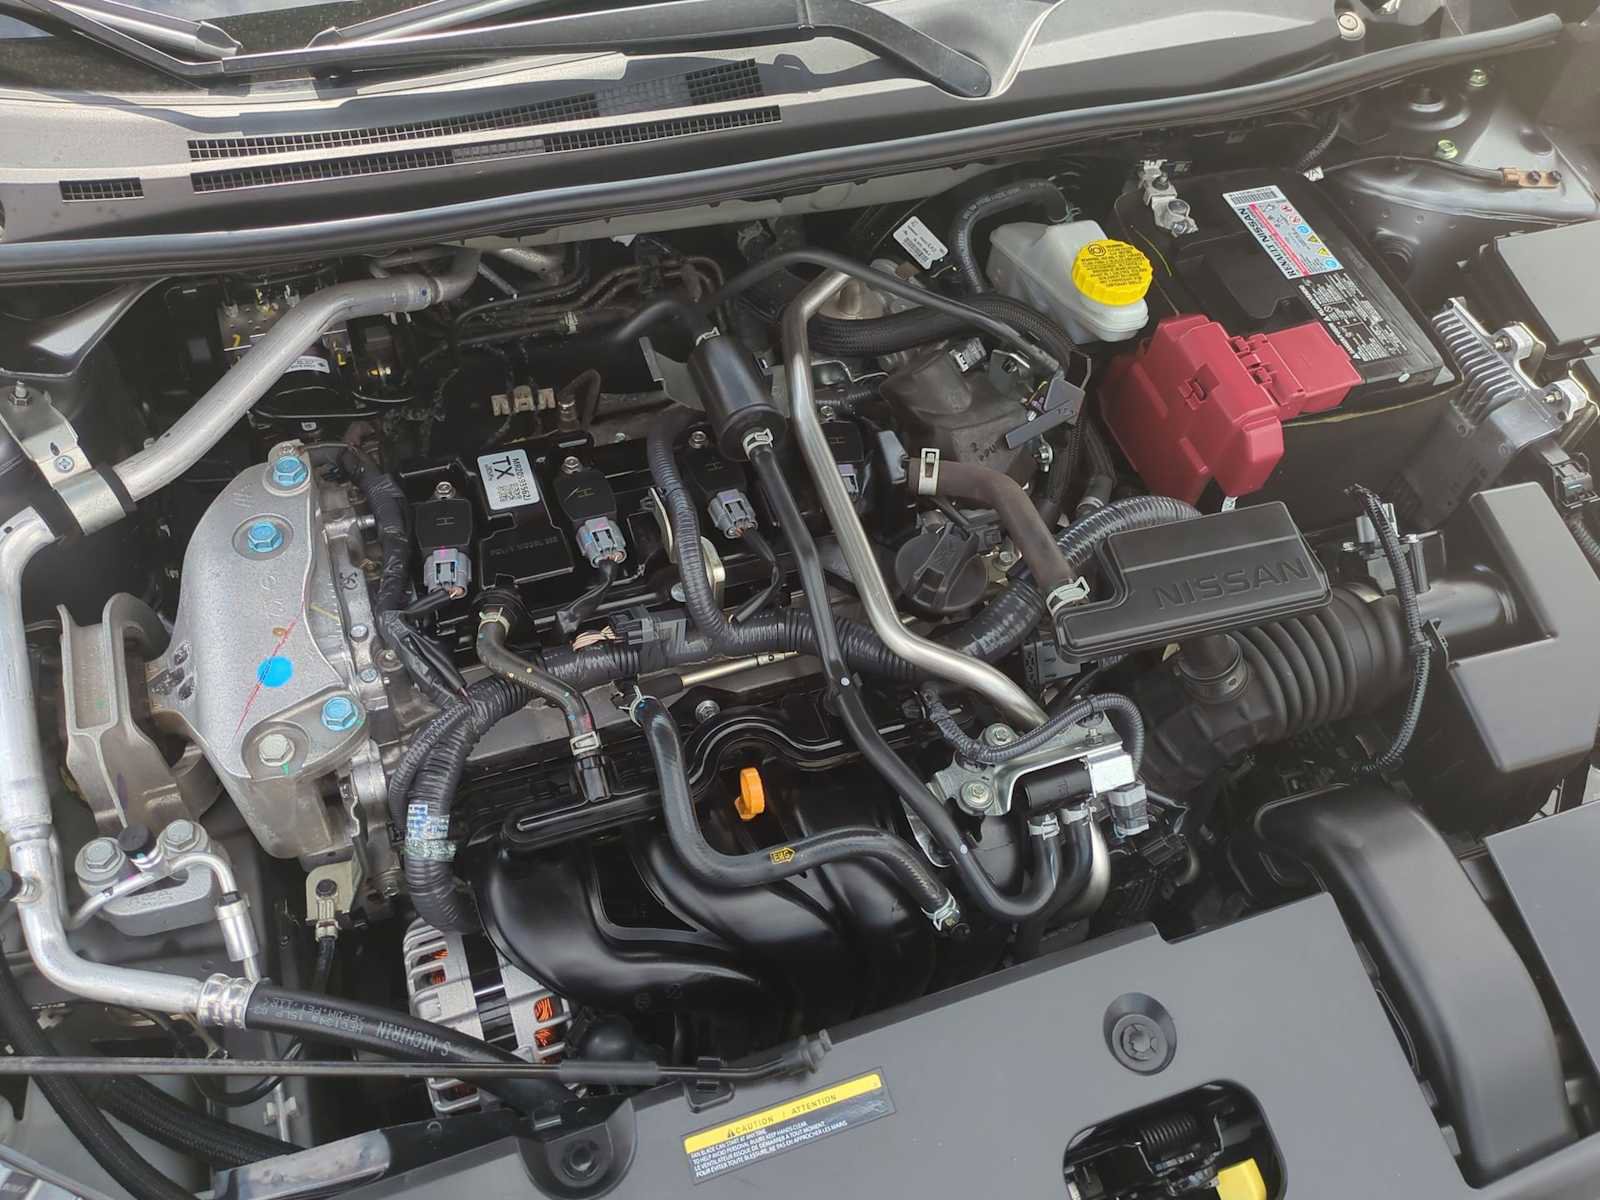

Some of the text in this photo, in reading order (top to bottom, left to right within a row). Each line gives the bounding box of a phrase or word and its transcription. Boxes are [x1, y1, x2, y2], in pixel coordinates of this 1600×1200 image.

[1236, 207, 1270, 242] NISSAN
[1263, 242, 1298, 276] RENAULT
[492, 455, 516, 480] TX
[1153, 557, 1310, 609] NISSAN
[735, 1115, 774, 1134] CAUTION
[791, 1094, 837, 1115] ATTENTION
